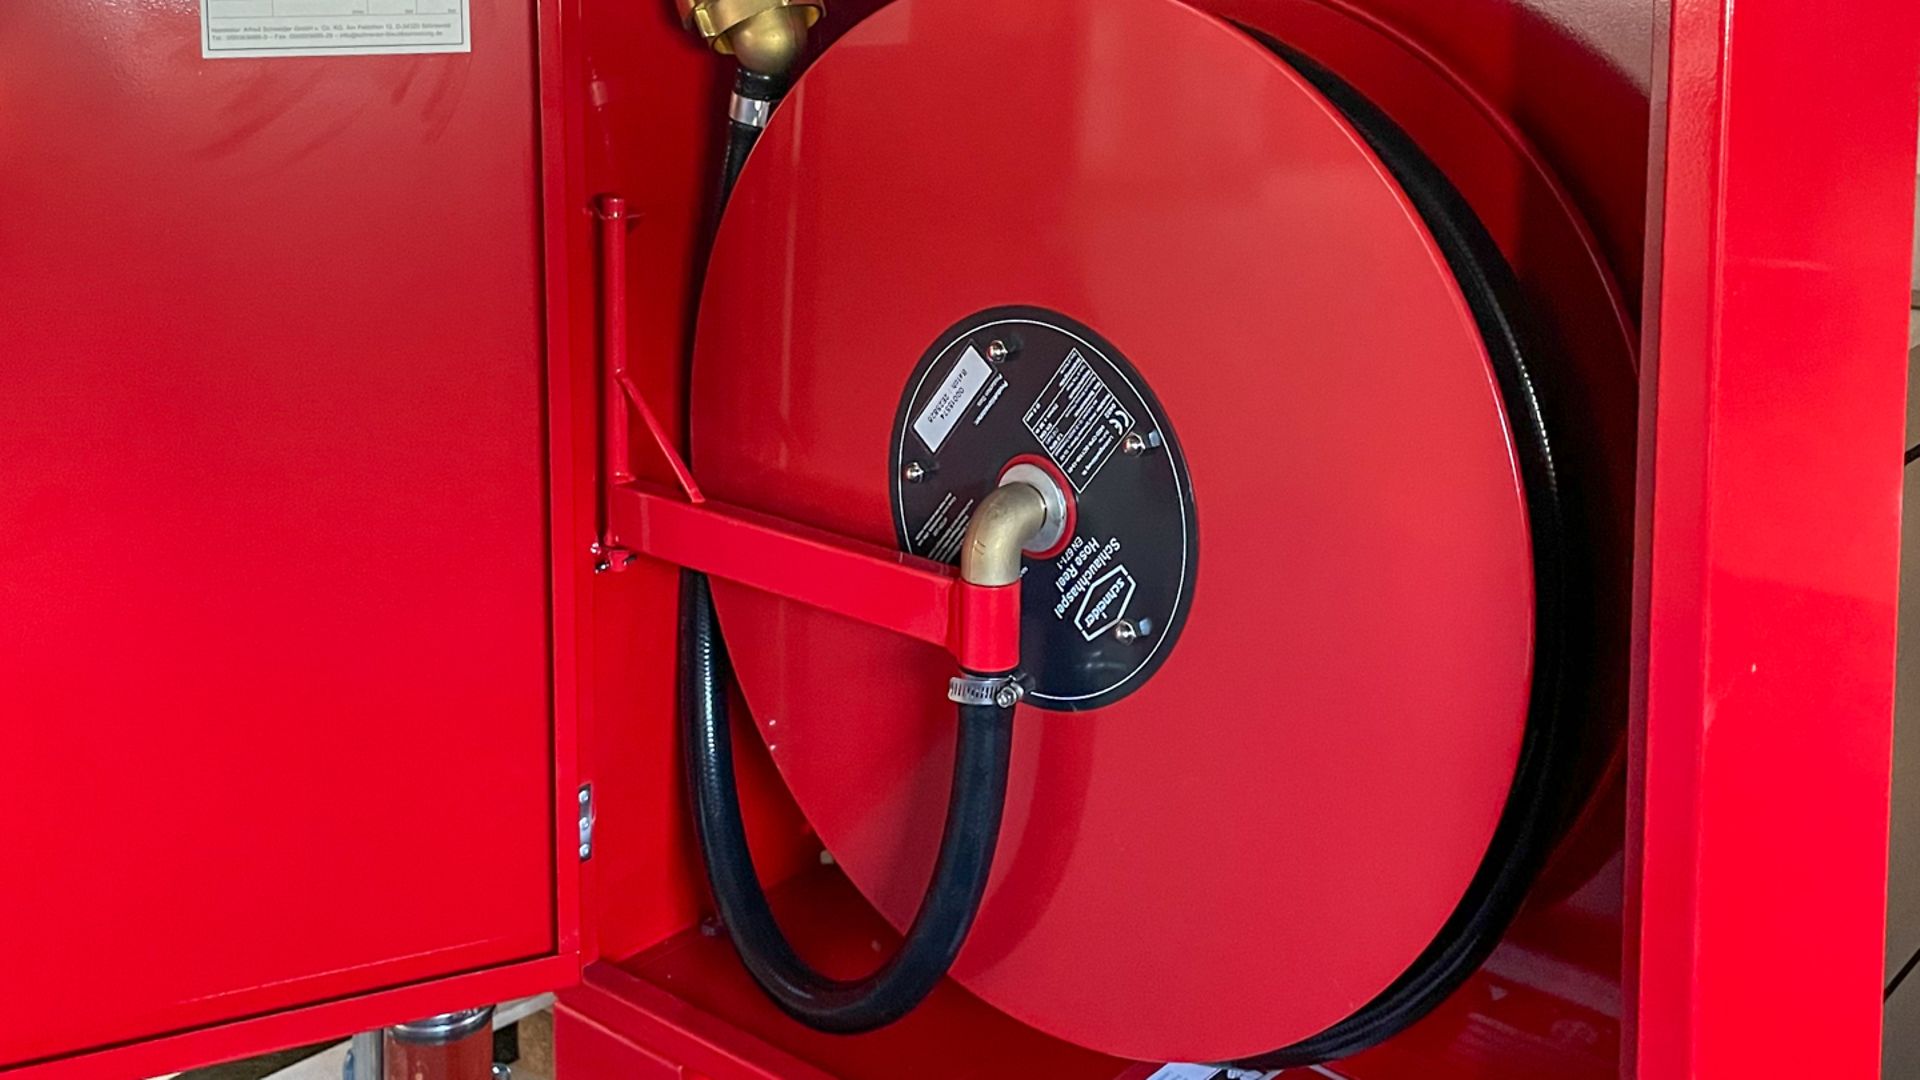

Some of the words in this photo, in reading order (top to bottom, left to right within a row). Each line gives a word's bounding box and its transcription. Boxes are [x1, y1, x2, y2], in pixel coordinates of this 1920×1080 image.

[1056, 547, 1074, 570] 671-1
[1071, 536, 1084, 551] EN
[1075, 536, 1100, 566] Hose
[1054, 537, 1121, 619] Schlauchhaspel
[1055, 563, 1078, 593] Reel
[1084, 577, 1125, 628] schneider
